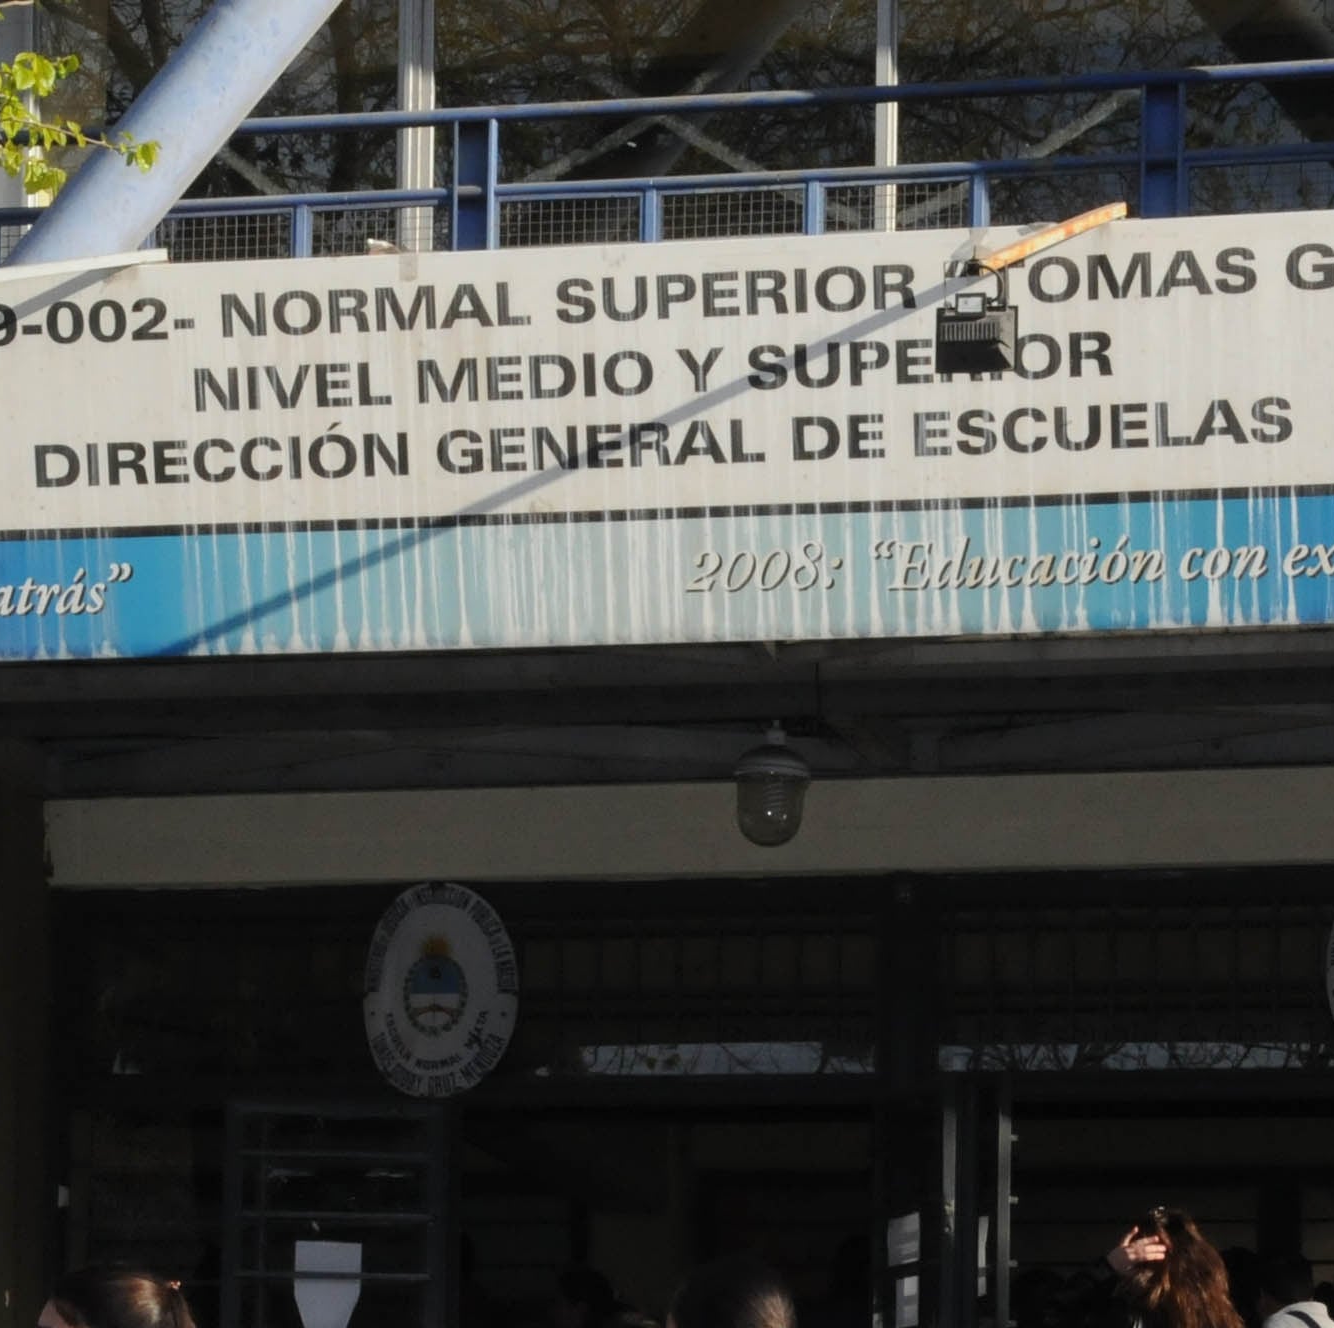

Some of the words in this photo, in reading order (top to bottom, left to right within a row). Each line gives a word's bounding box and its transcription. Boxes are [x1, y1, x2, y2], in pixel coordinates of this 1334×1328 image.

[222, 282, 530, 338] NORMAL
[556, 264, 916, 325] SUPERIOR
[194, 363, 392, 412] NIVEL
[419, 350, 654, 403] MEDIO
[675, 347, 725, 393] Y
[748, 330, 1113, 391] SUPEOR
[35, 422, 408, 489] DIRECCIÓN
[438, 419, 765, 475] GENERAL
[793, 413, 885, 461] DE
[914, 396, 1293, 459] ESCUELAS
[685, 542, 842, 595] 2008:
[1179, 540, 1267, 585] con
